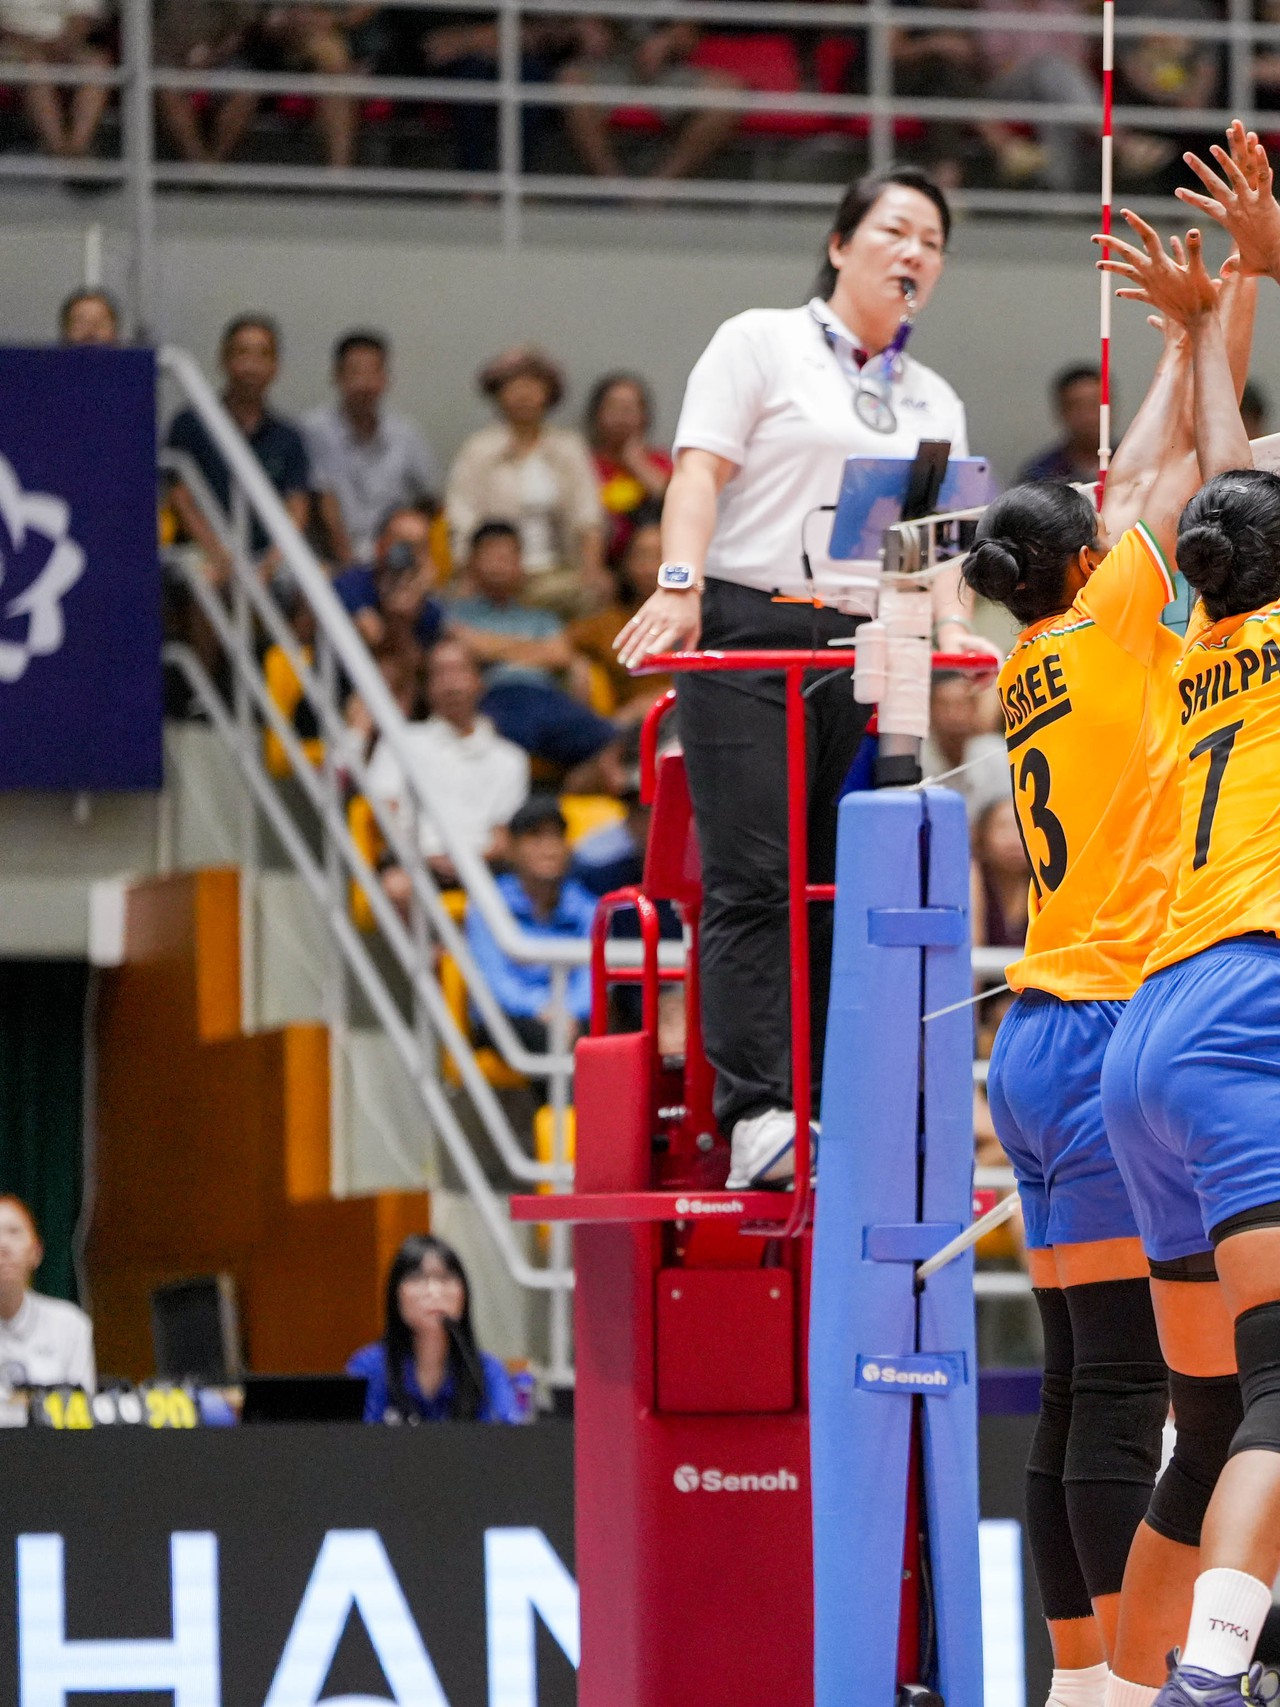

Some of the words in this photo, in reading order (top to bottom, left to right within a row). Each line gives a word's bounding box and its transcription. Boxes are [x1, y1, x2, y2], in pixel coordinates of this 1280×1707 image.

[1189, 718, 1244, 871] 7
[690, 1200, 744, 1214] Senoh
[881, 1368, 948, 1386] Senoh
[701, 1467, 798, 1491] Senoh
[1209, 1617, 1249, 1641] TYKA
